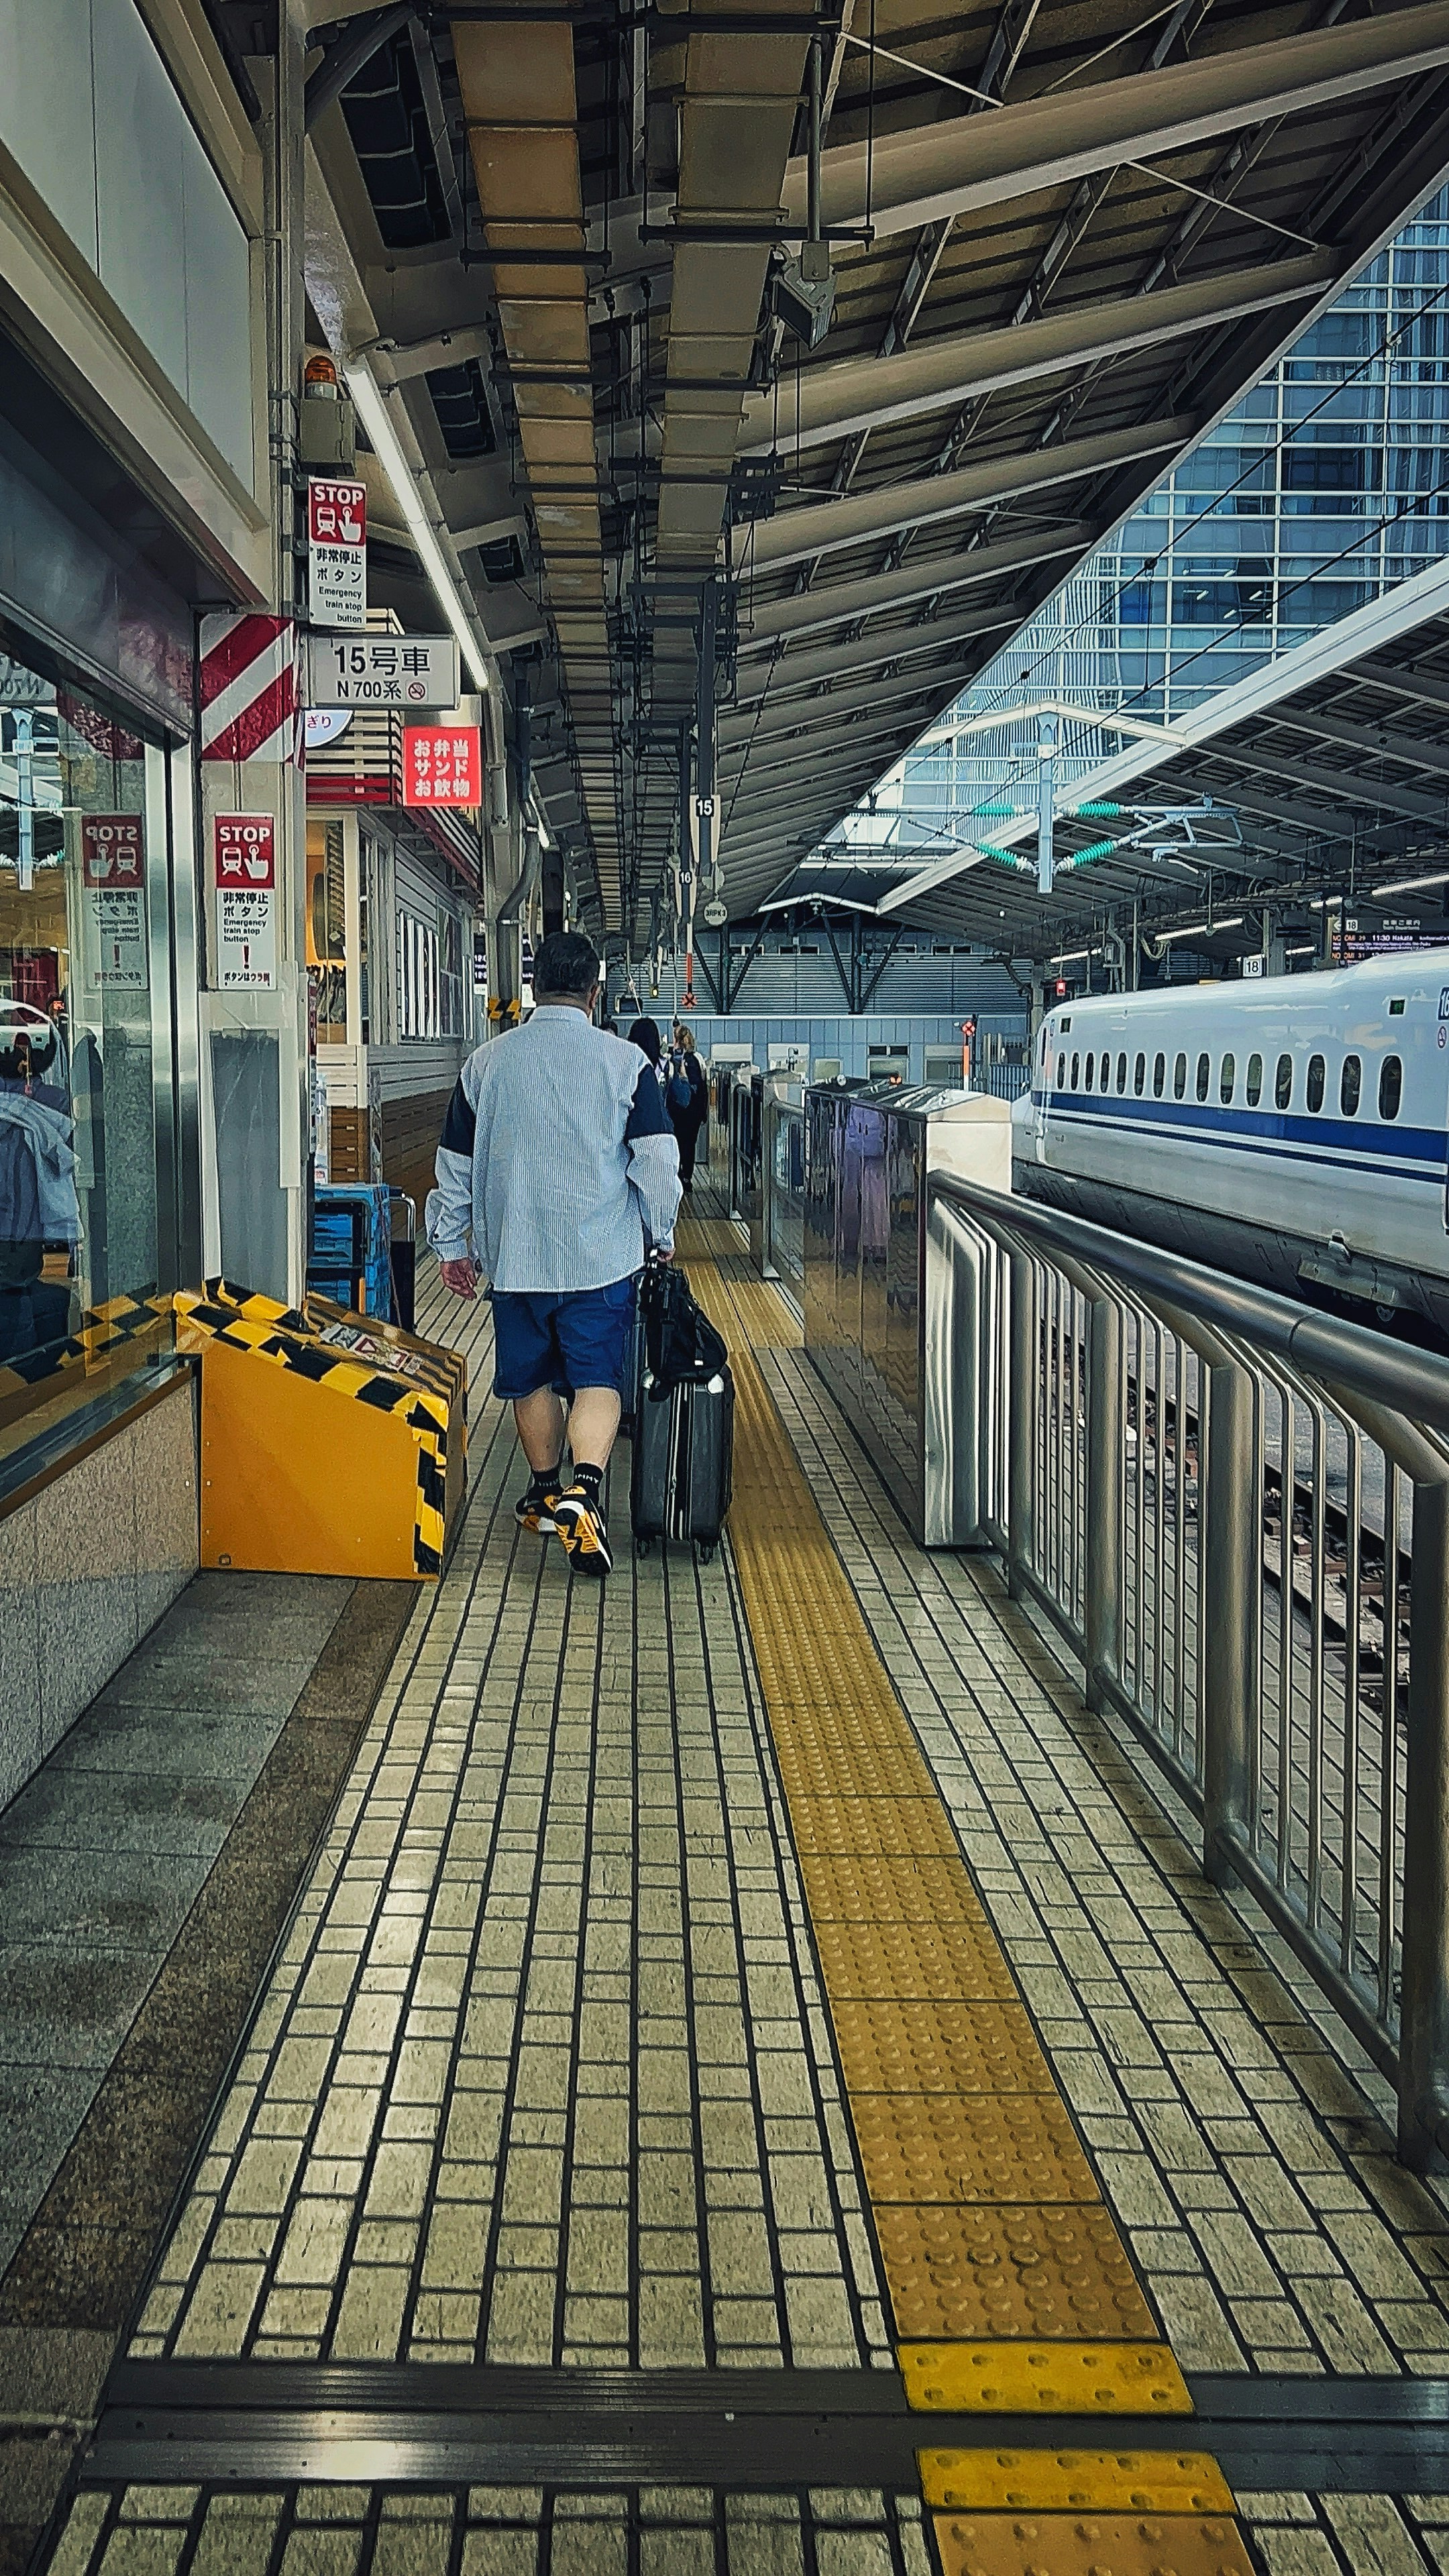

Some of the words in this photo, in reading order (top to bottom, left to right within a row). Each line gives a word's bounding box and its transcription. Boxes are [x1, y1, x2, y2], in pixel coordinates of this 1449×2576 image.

[315, 486, 363, 505] STOP
[316, 547, 362, 565] 非常停止
[317, 568, 362, 583] ボタン
[319, 586, 362, 599] Emergency
[325, 600, 343, 609] train
[345, 601, 362, 612] stop
[337, 613, 362, 623] button
[335, 645, 431, 676] 15号車
[414, 739, 469, 757] お弁当
[415, 759, 469, 777] サンド
[415, 778, 470, 798] お飲物
[698, 800, 712, 816] 15
[219, 826, 270, 843] STOP
[680, 871, 691, 883] 16
[223, 892, 269, 904] 非常停止
[223, 906, 268, 918] ボタン
[223, 919, 267, 927] Emergency
[1348, 921, 1356, 929] 18
[243, 927, 260, 935] stop
[1246, 961, 1258, 973] 18
